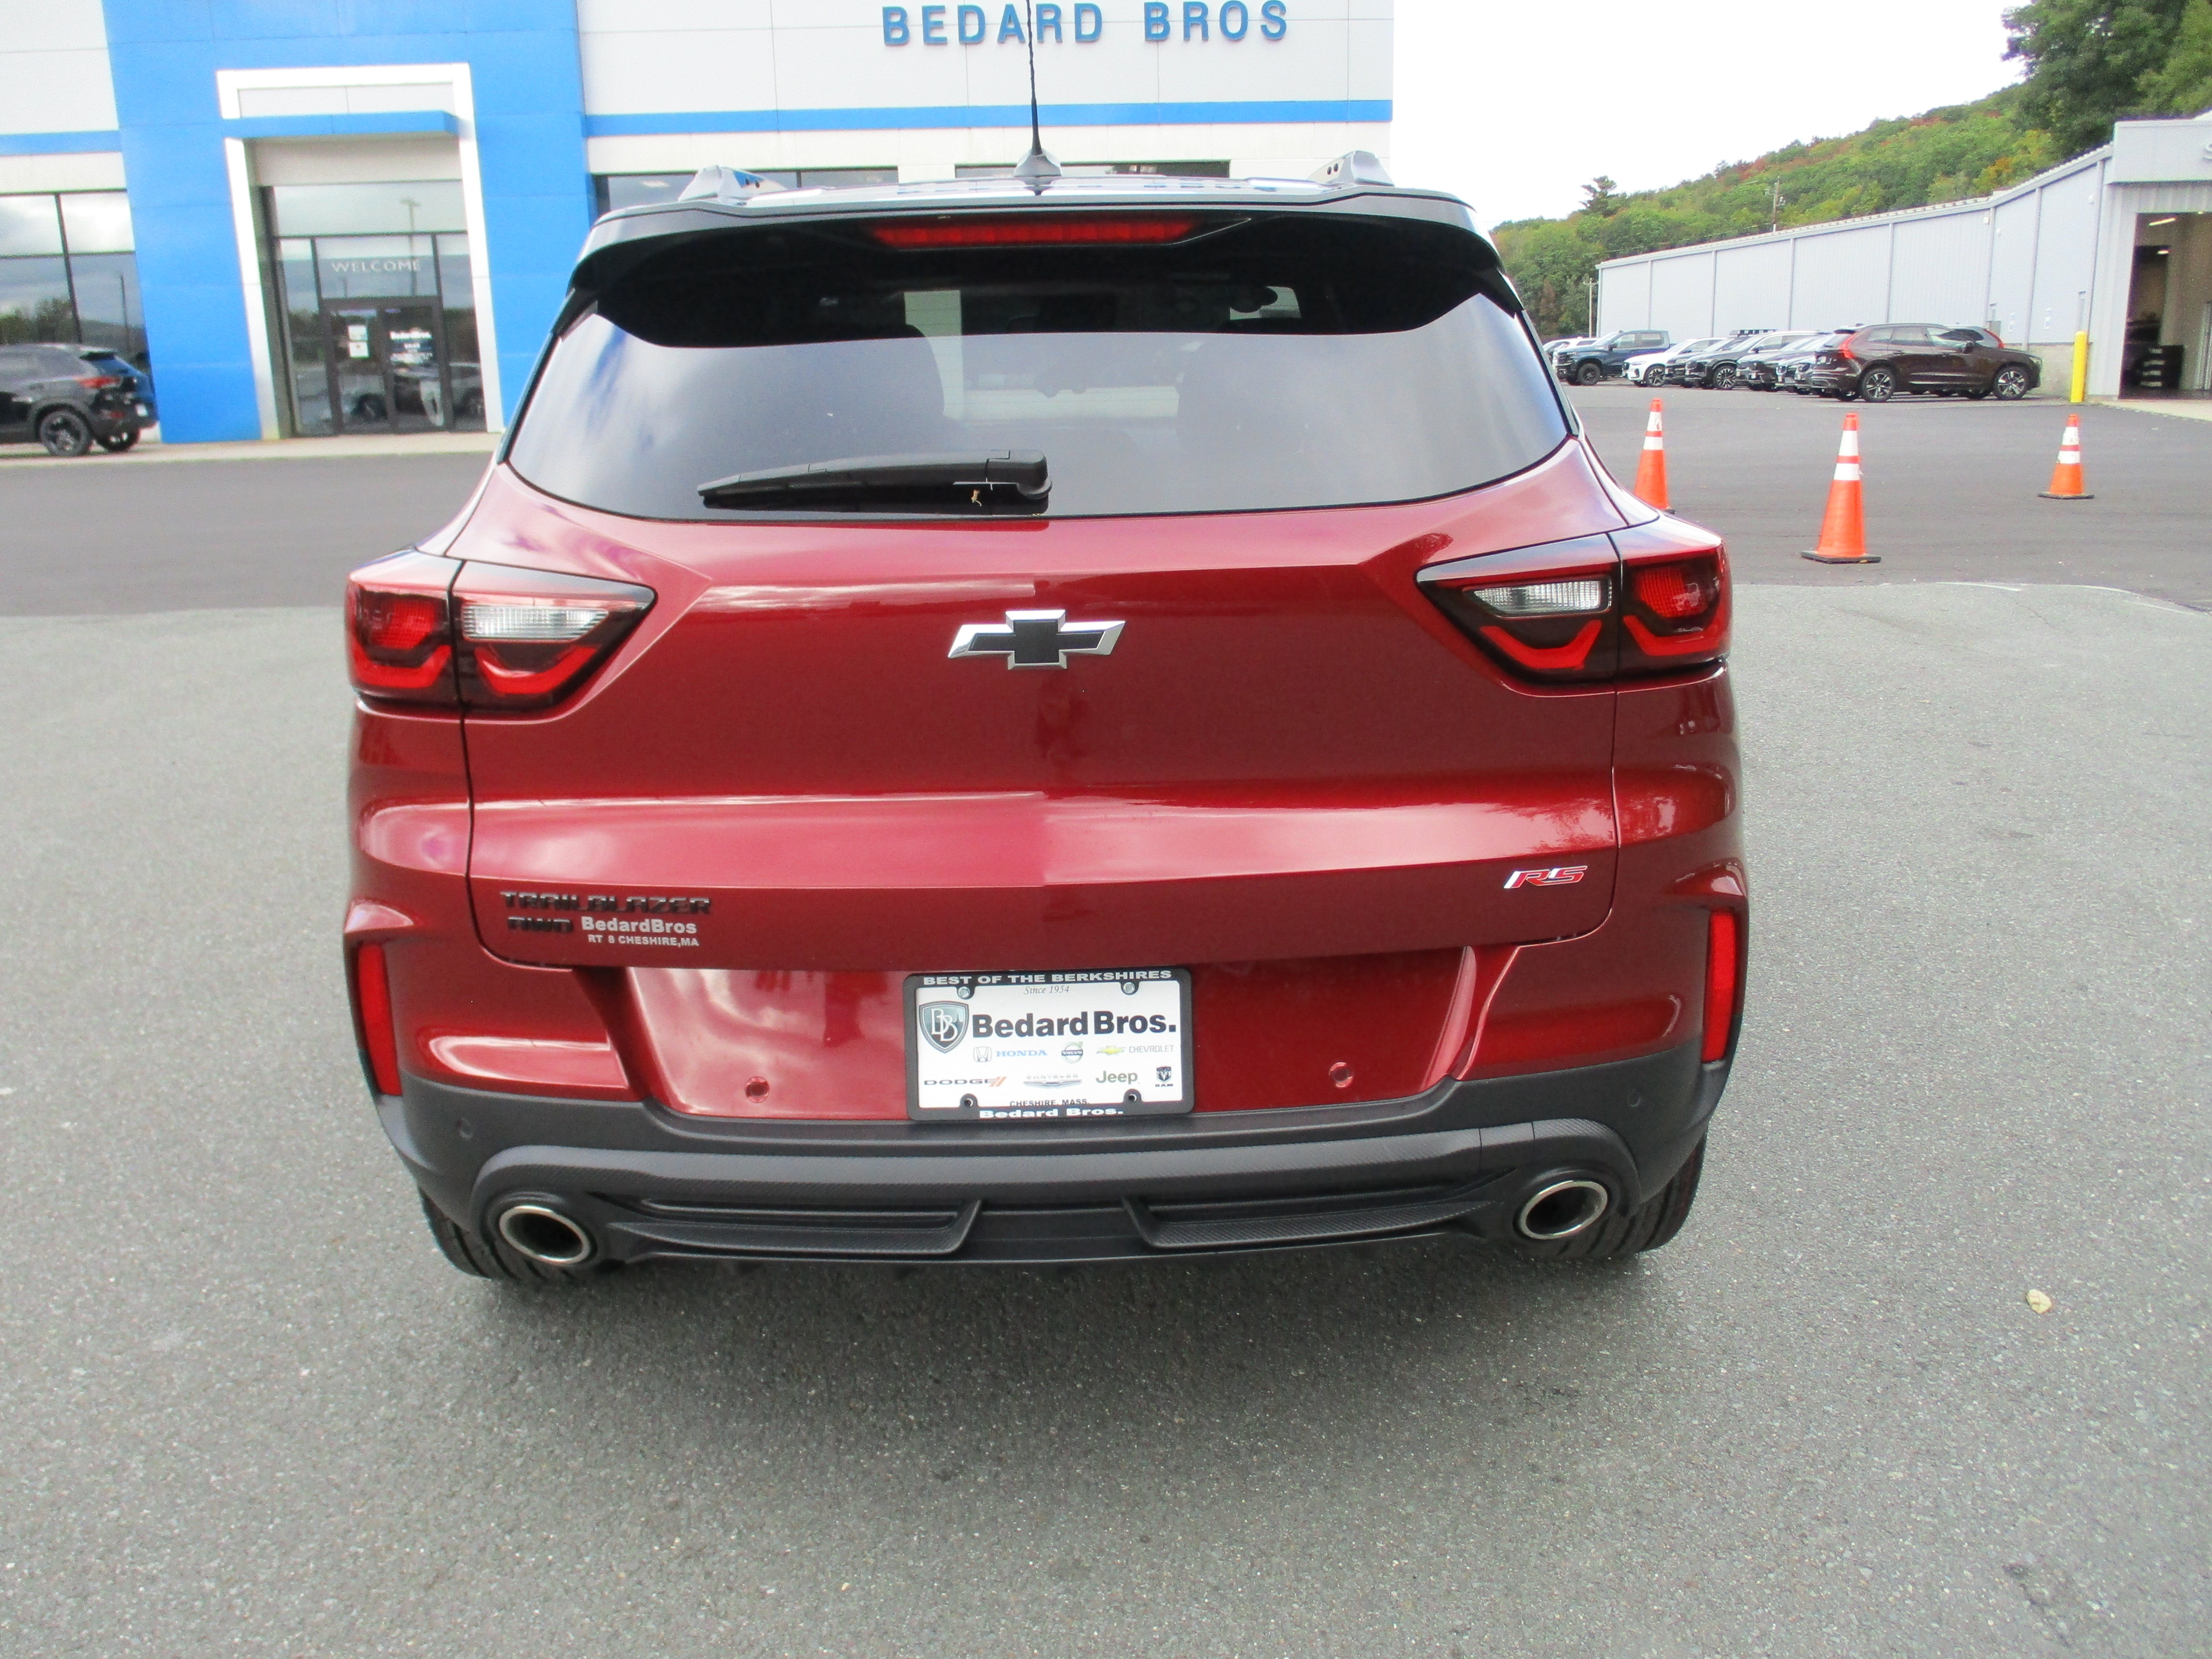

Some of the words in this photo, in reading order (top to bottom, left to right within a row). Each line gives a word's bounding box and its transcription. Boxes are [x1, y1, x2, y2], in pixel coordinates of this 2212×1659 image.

[882, 3, 1103, 46] BEDARD
[1144, 0, 1287, 41] BROS
[331, 258, 420, 272] WELCOME
[1504, 866, 1588, 889] RS
[500, 891, 711, 914] TRAILBLAZER
[581, 916, 697, 934] BedardBros
[587, 934, 603, 943] RT
[924, 976, 972, 985] BEST
[977, 975, 1002, 984] OF
[1008, 974, 1046, 983] THE
[1052, 970, 1172, 982] BERKSHIRES
[1024, 985, 1046, 995] Since
[1049, 985, 1070, 994] 1954
[972, 1012, 1088, 1038] Bedard
[1094, 1011, 1176, 1034] Bros.
[1129, 1045, 1174, 1053] CHEVROLET
[1096, 1070, 1138, 1084] Jeep
[979, 1109, 1058, 1118] Bedard
[1066, 1108, 1124, 1116] Bros.
